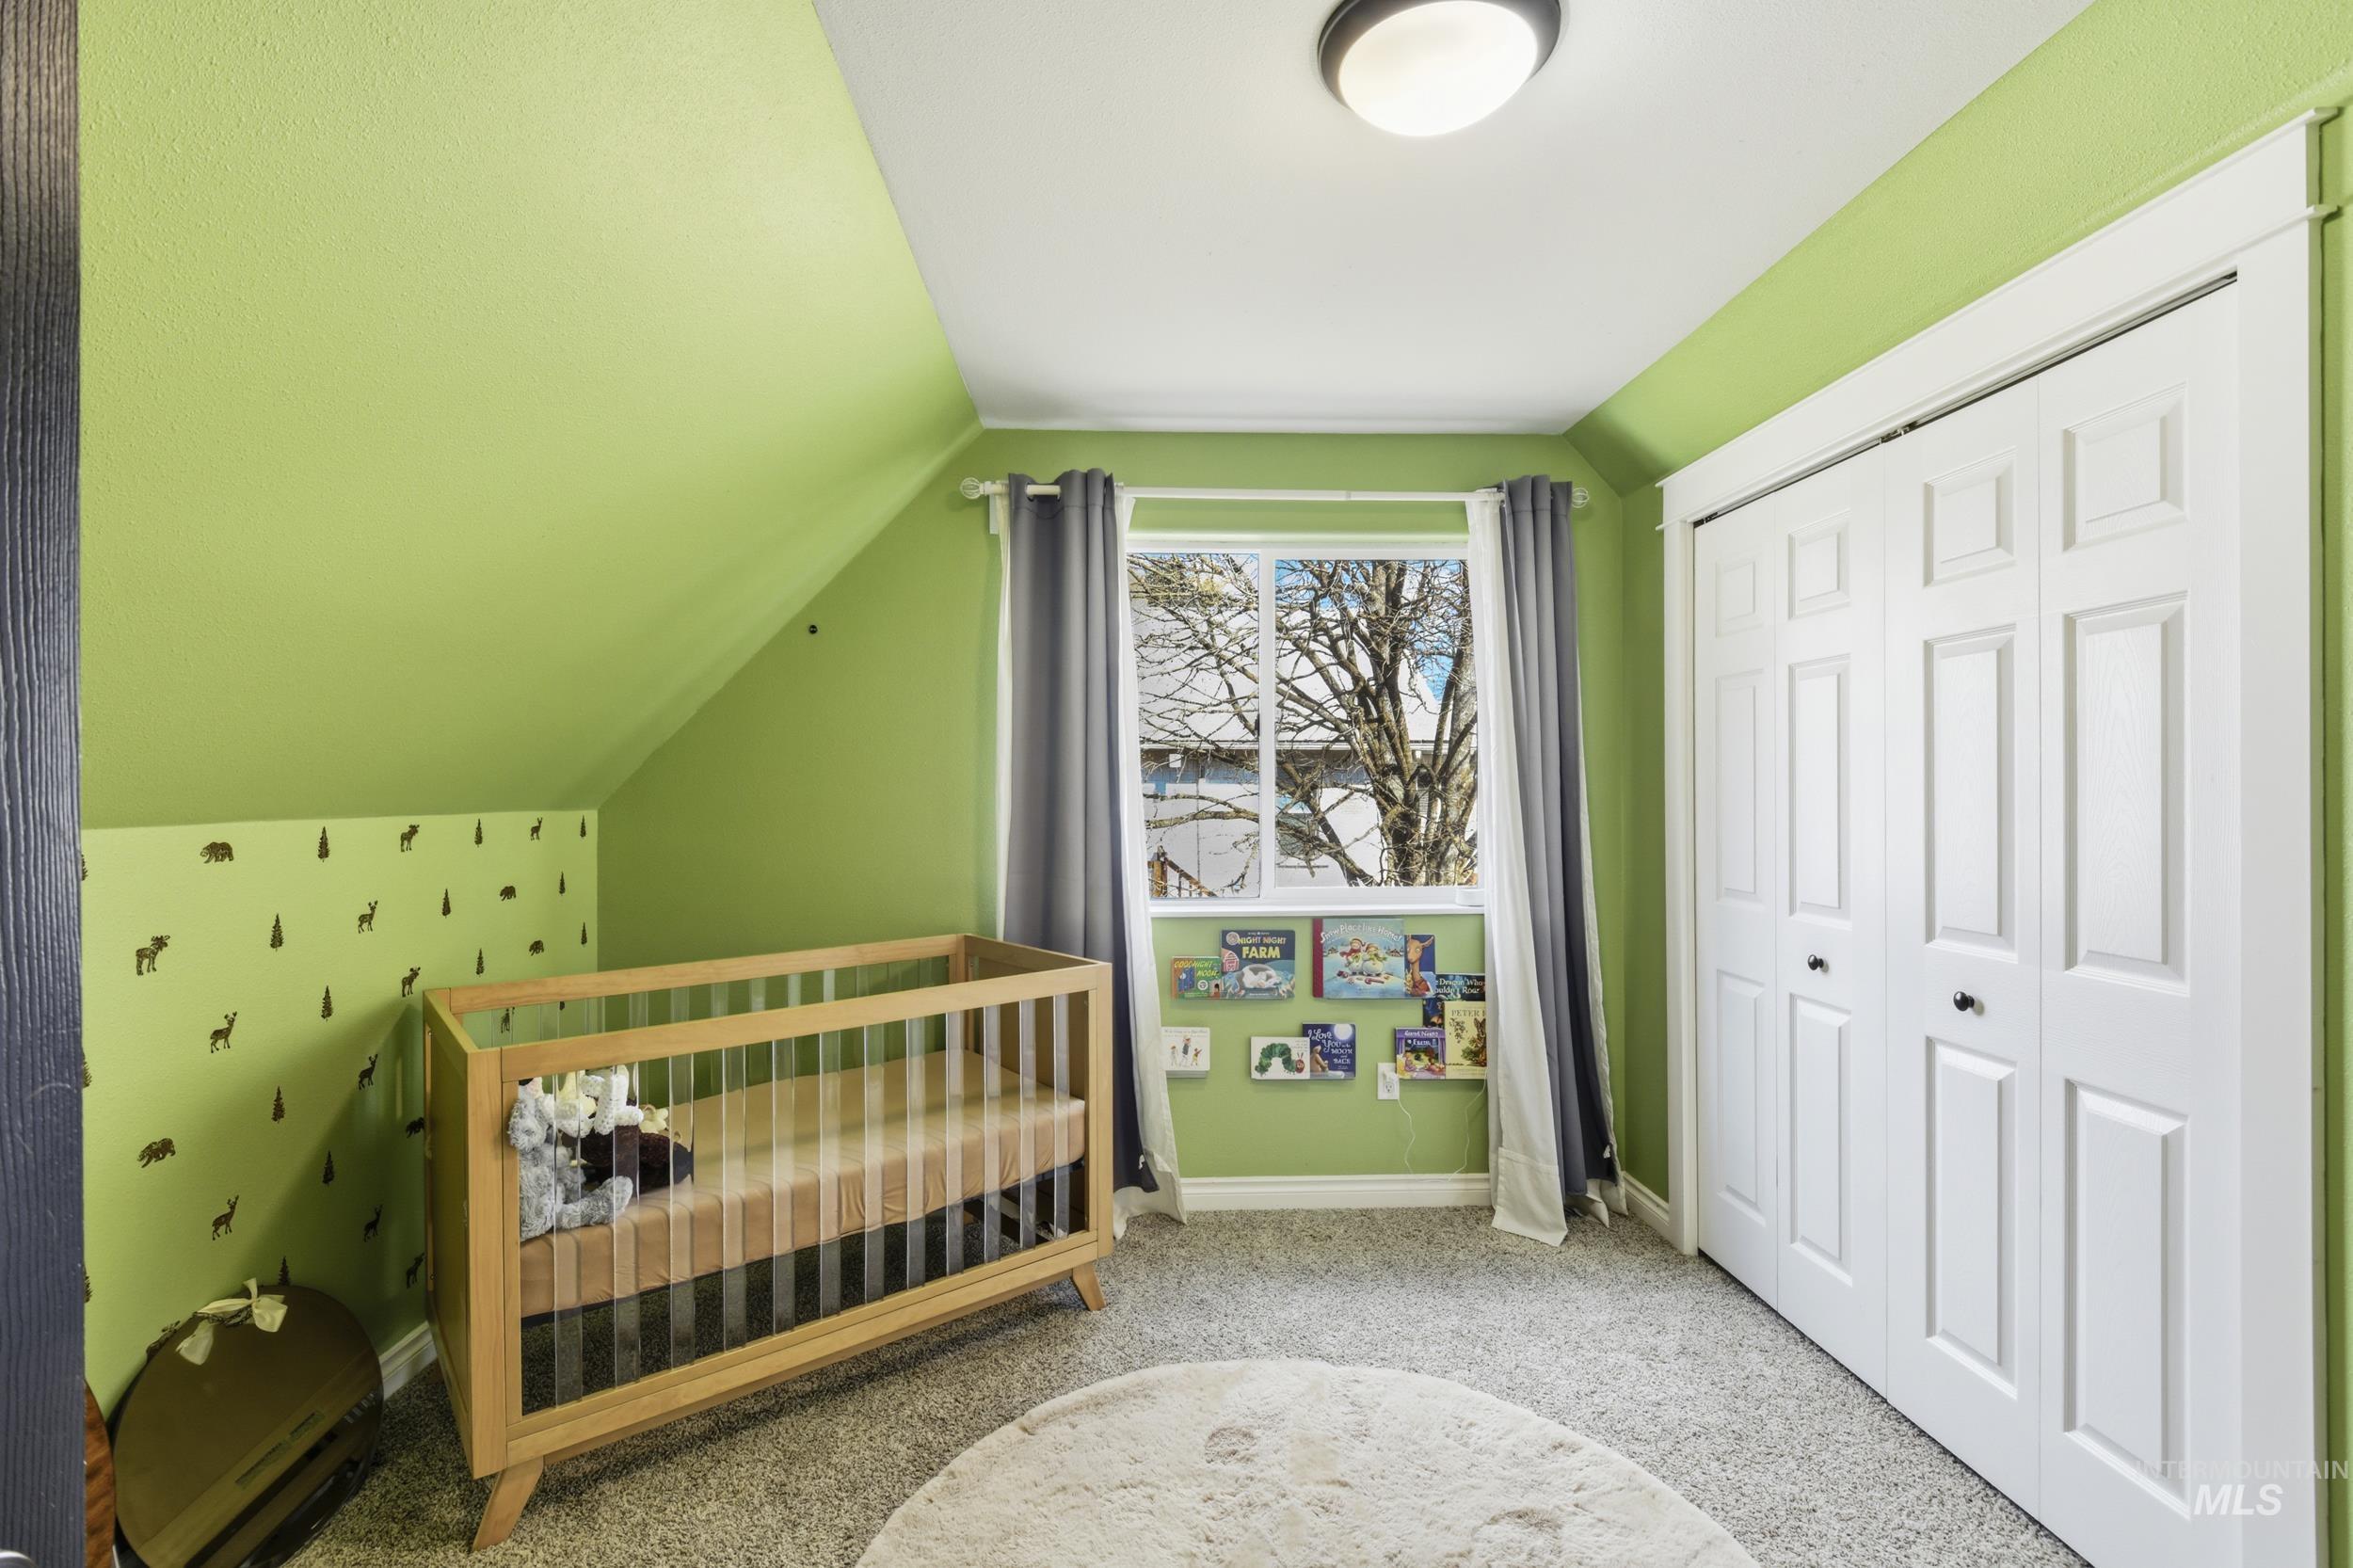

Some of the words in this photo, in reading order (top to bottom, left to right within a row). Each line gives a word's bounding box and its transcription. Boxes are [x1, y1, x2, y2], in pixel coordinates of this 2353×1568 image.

[1238, 936, 1261, 945] NIGHT
[1262, 936, 1287, 945] NIGHT
[1241, 946, 1281, 959] FARM
[1174, 960, 1212, 969] GOODNIGHT
[1451, 1009, 1480, 1017] PETER
